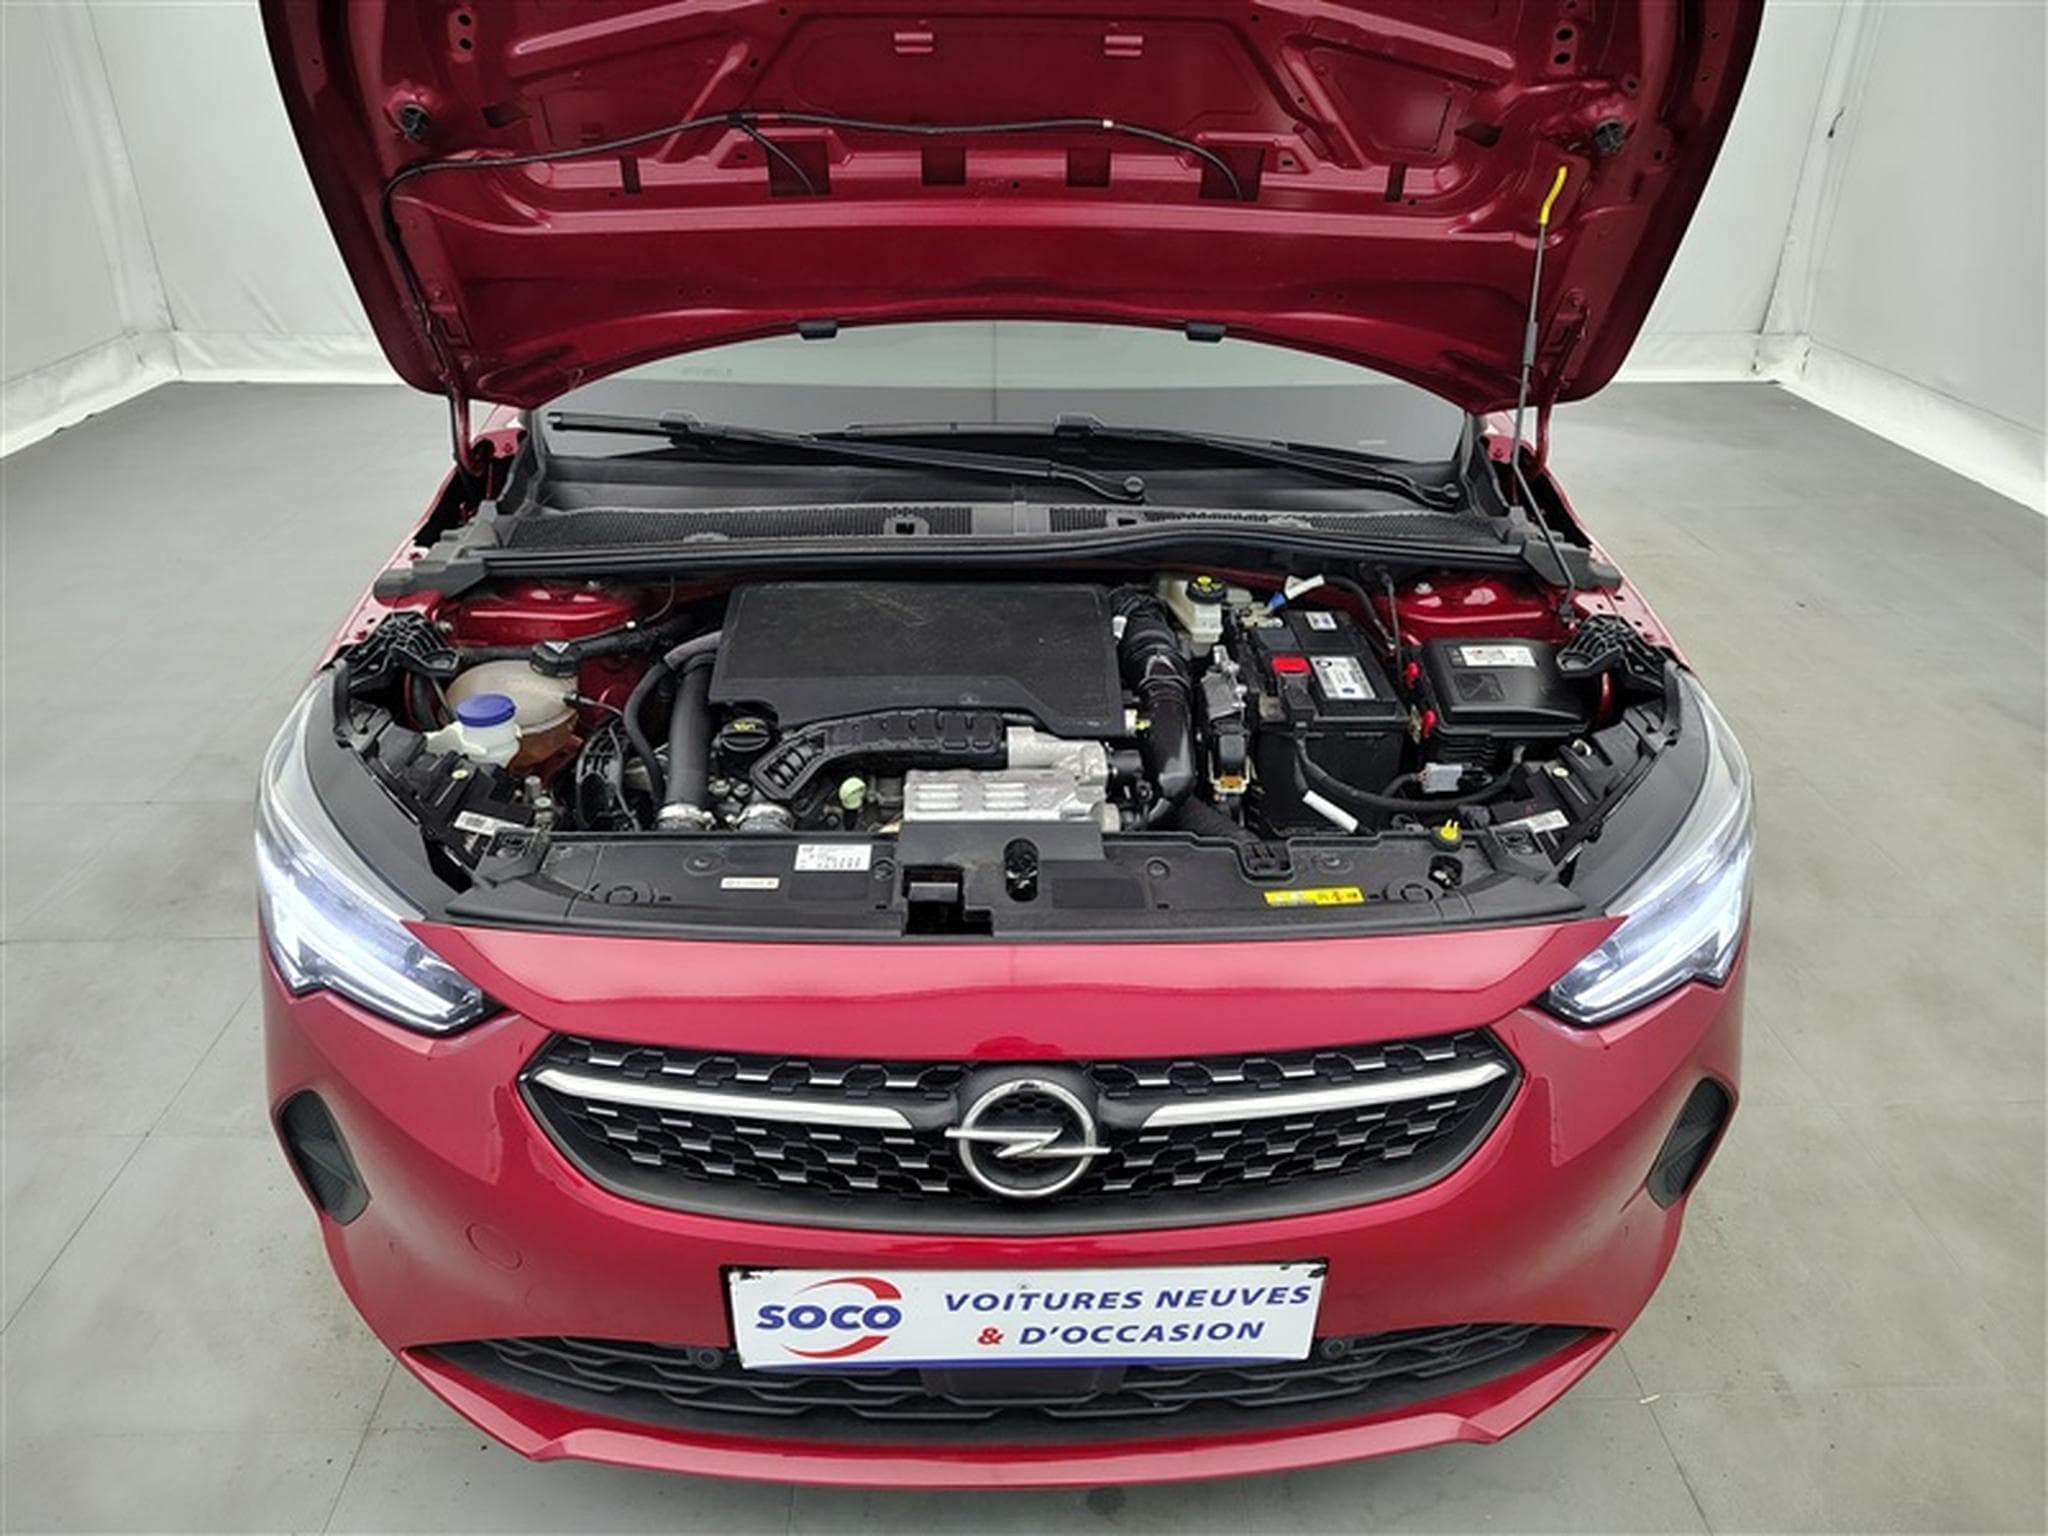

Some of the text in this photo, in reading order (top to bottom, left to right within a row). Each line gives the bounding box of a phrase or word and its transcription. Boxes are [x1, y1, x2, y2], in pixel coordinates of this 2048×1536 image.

[944, 1285, 1312, 1313] VOITURES NEUVES
[756, 1303, 903, 1332] SOCO
[977, 1321, 1265, 1347] & D'OCCASION
